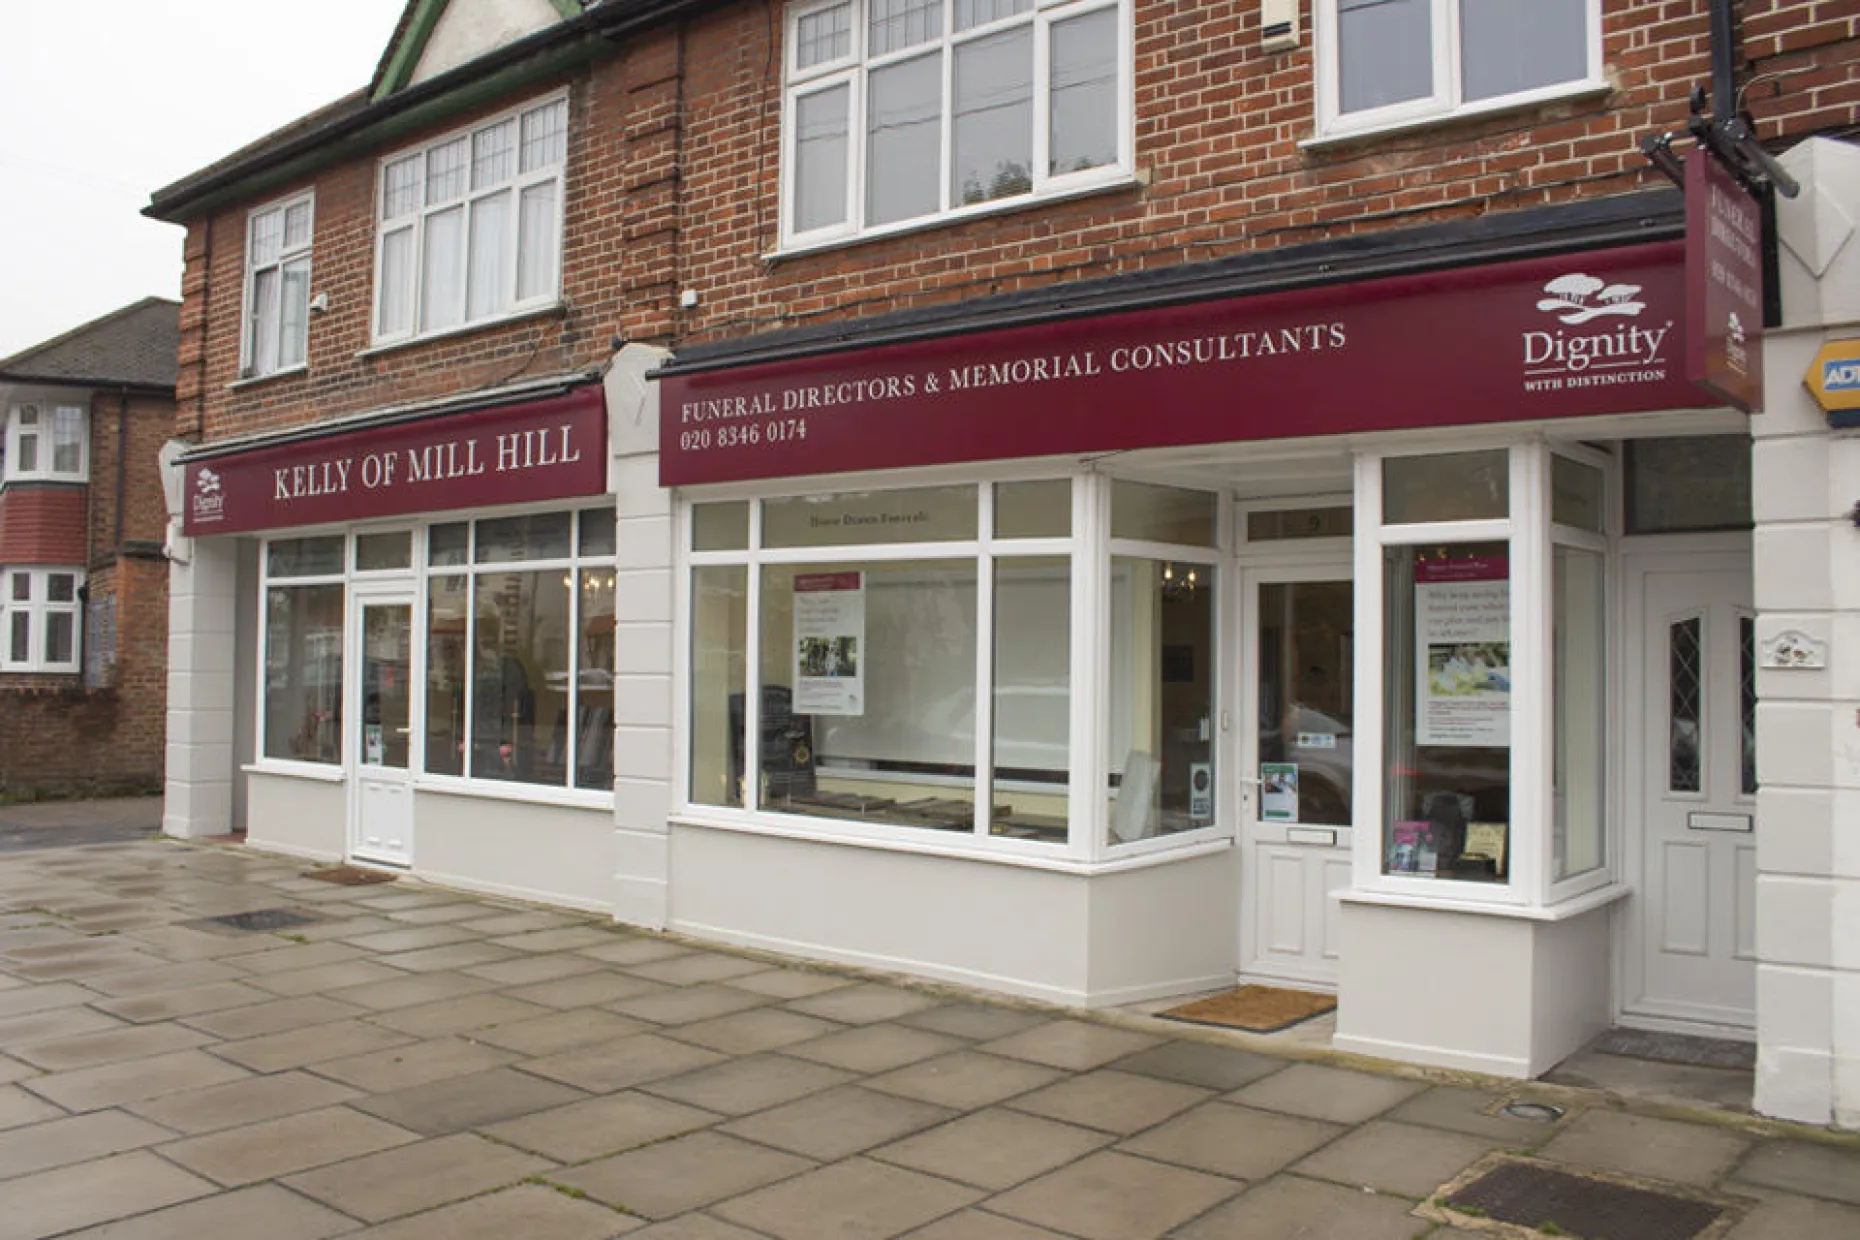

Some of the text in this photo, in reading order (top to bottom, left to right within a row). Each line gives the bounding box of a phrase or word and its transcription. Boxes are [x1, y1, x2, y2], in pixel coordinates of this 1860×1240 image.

[1522, 322, 1667, 371] Dignity
[681, 322, 1346, 423] FUNERAL DIRECTORS & MEMORIAL CONSULTANTS
[1524, 370, 1666, 392] WITH DISTINCTION
[1824, 365, 1860, 388] AD
[681, 418, 807, 450] 020 8346 0174
[273, 425, 580, 500] KELLY OF MILL HILL
